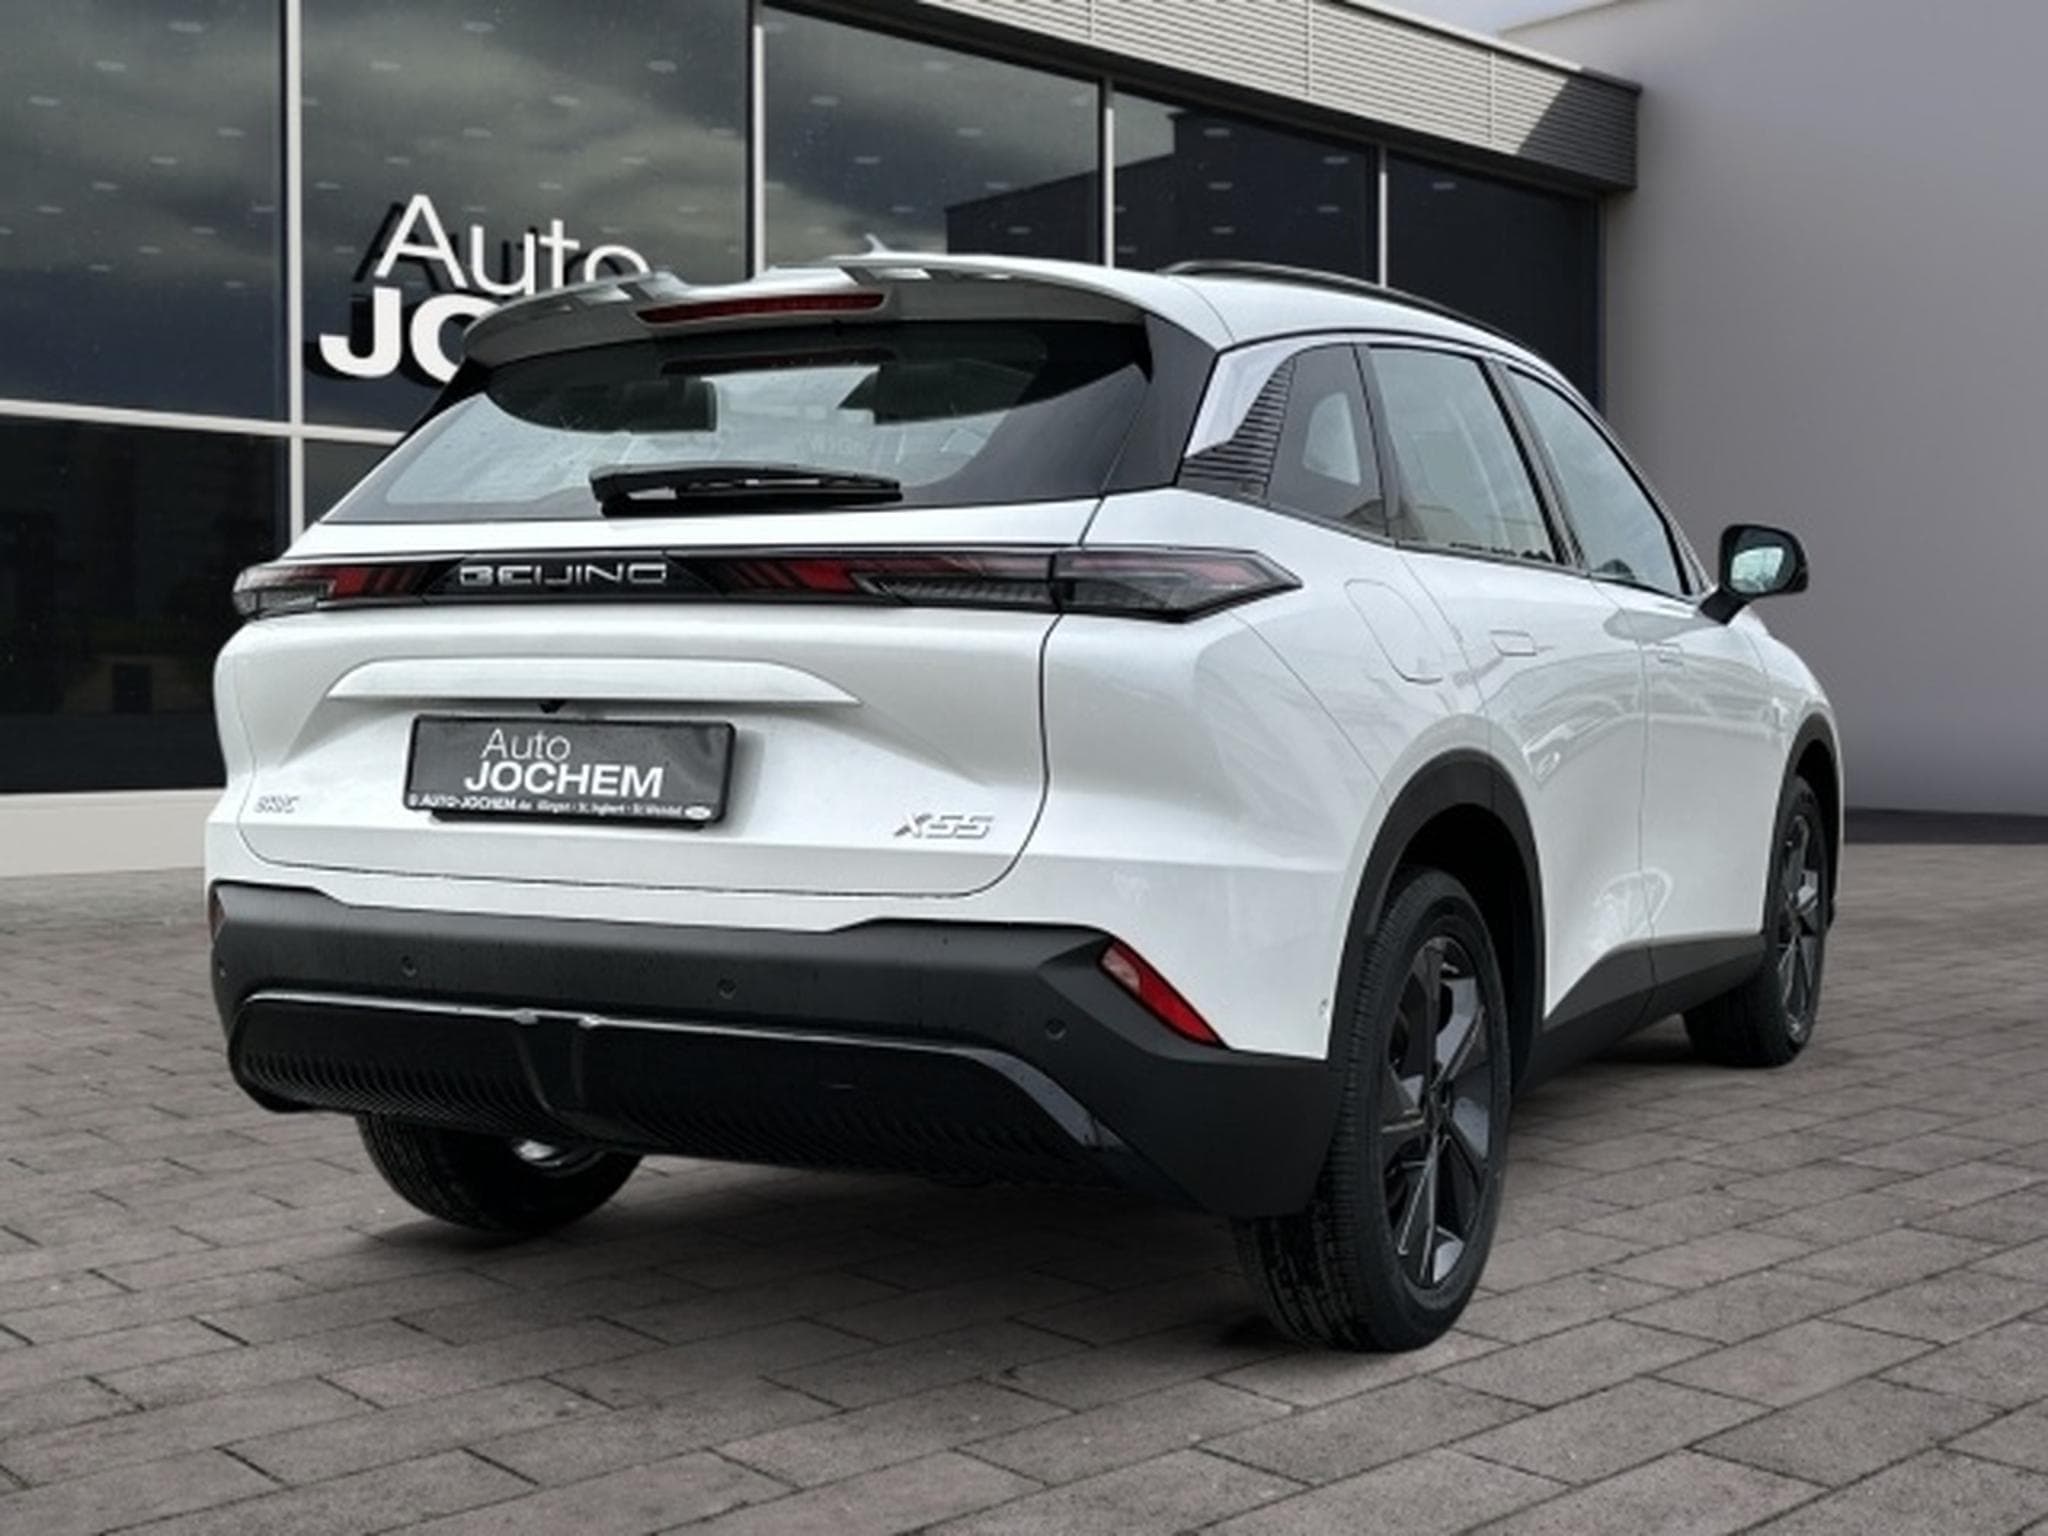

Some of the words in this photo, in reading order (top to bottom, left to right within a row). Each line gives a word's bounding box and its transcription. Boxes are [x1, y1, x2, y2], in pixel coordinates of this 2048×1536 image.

[459, 563, 668, 587] BEIJING
[480, 728, 571, 761] Auto
[464, 760, 664, 798] JOCHEM
